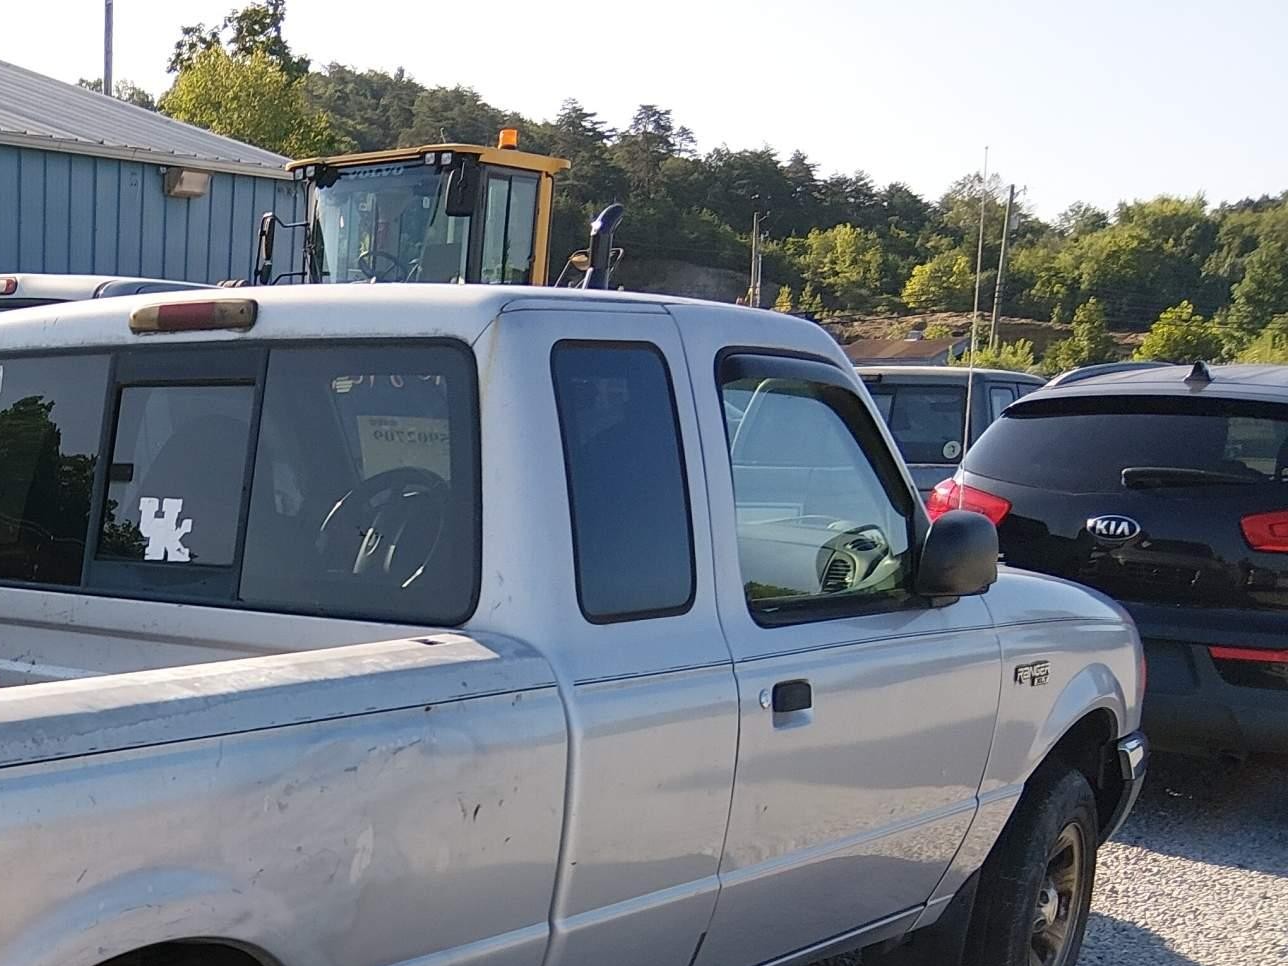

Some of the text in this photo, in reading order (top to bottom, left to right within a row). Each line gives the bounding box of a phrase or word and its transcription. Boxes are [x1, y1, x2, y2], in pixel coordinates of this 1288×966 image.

[139, 497, 193, 562] UK
[1095, 519, 1130, 536] KIA
[1015, 662, 1051, 684] RANGER
